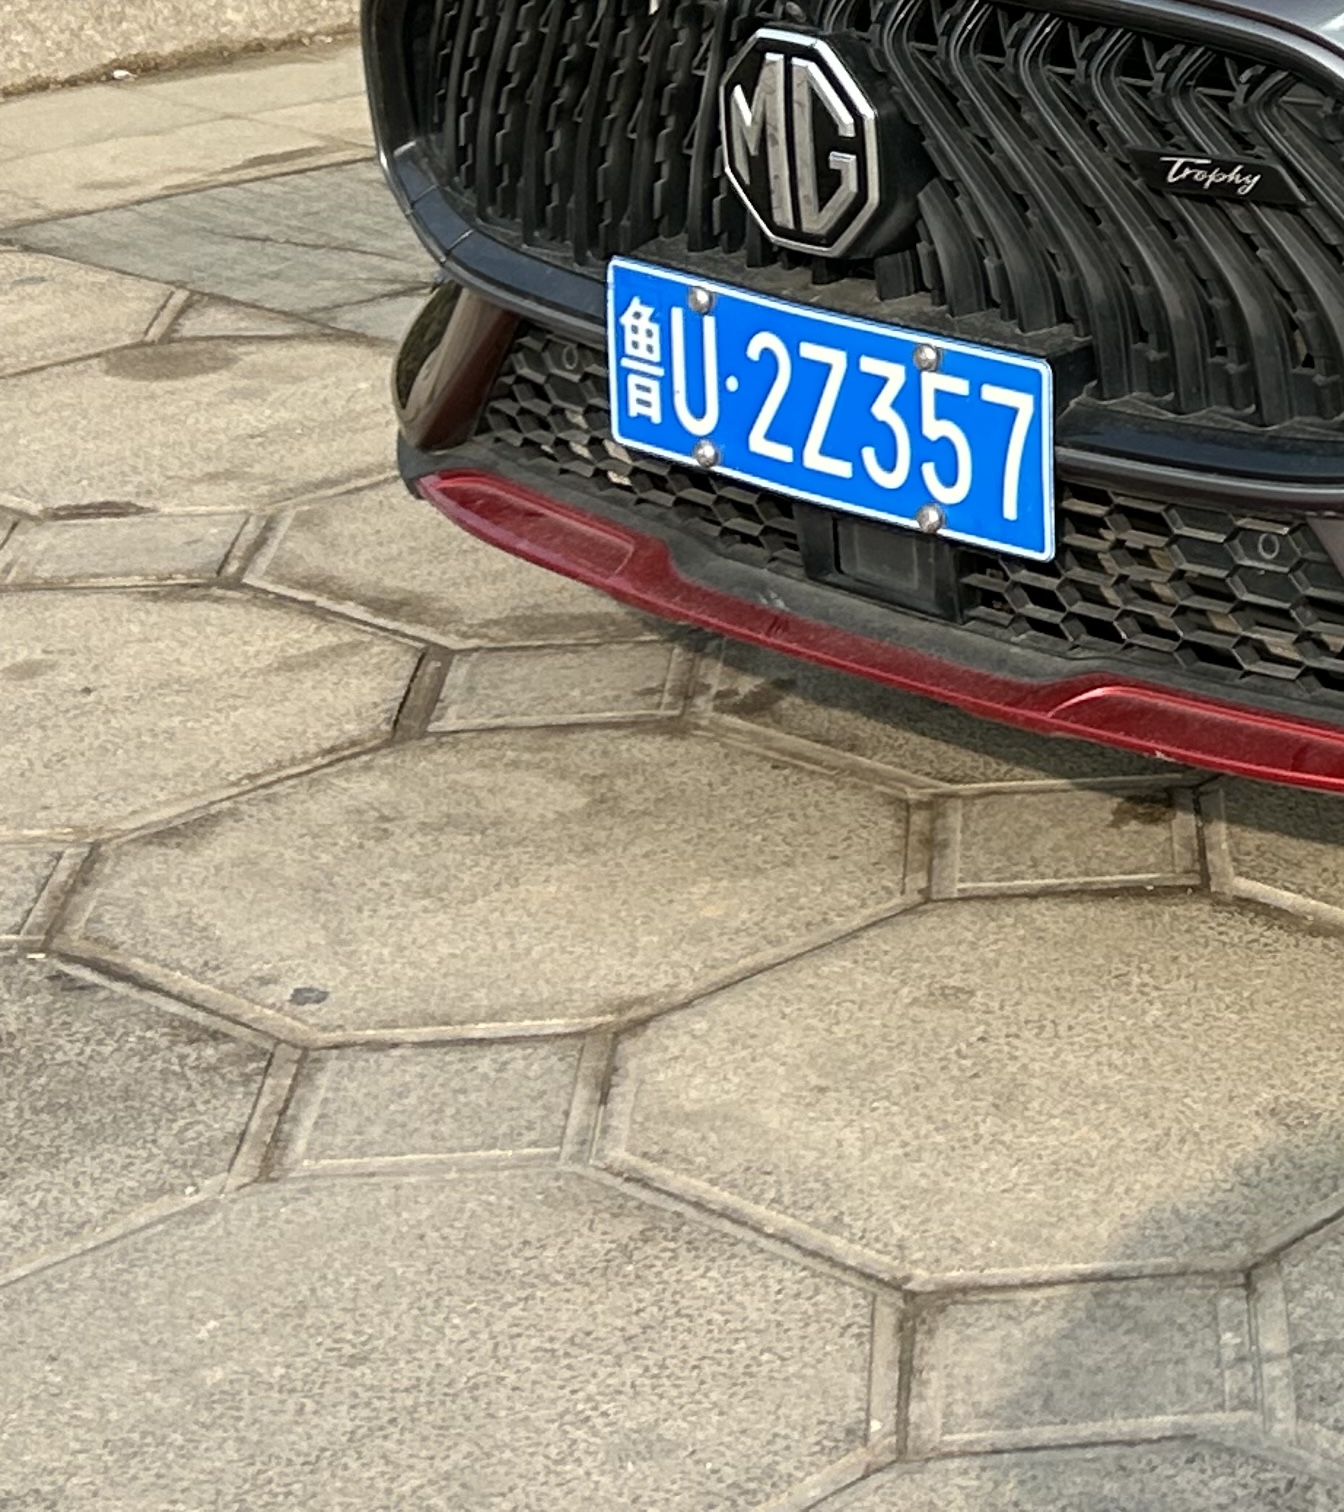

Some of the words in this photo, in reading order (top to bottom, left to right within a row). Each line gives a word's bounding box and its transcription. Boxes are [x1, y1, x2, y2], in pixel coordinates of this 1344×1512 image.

[731, 50, 857, 237] MG
[1160, 156, 1261, 195] Trophy
[619, 296, 1035, 522] 鲁U·2Z357
